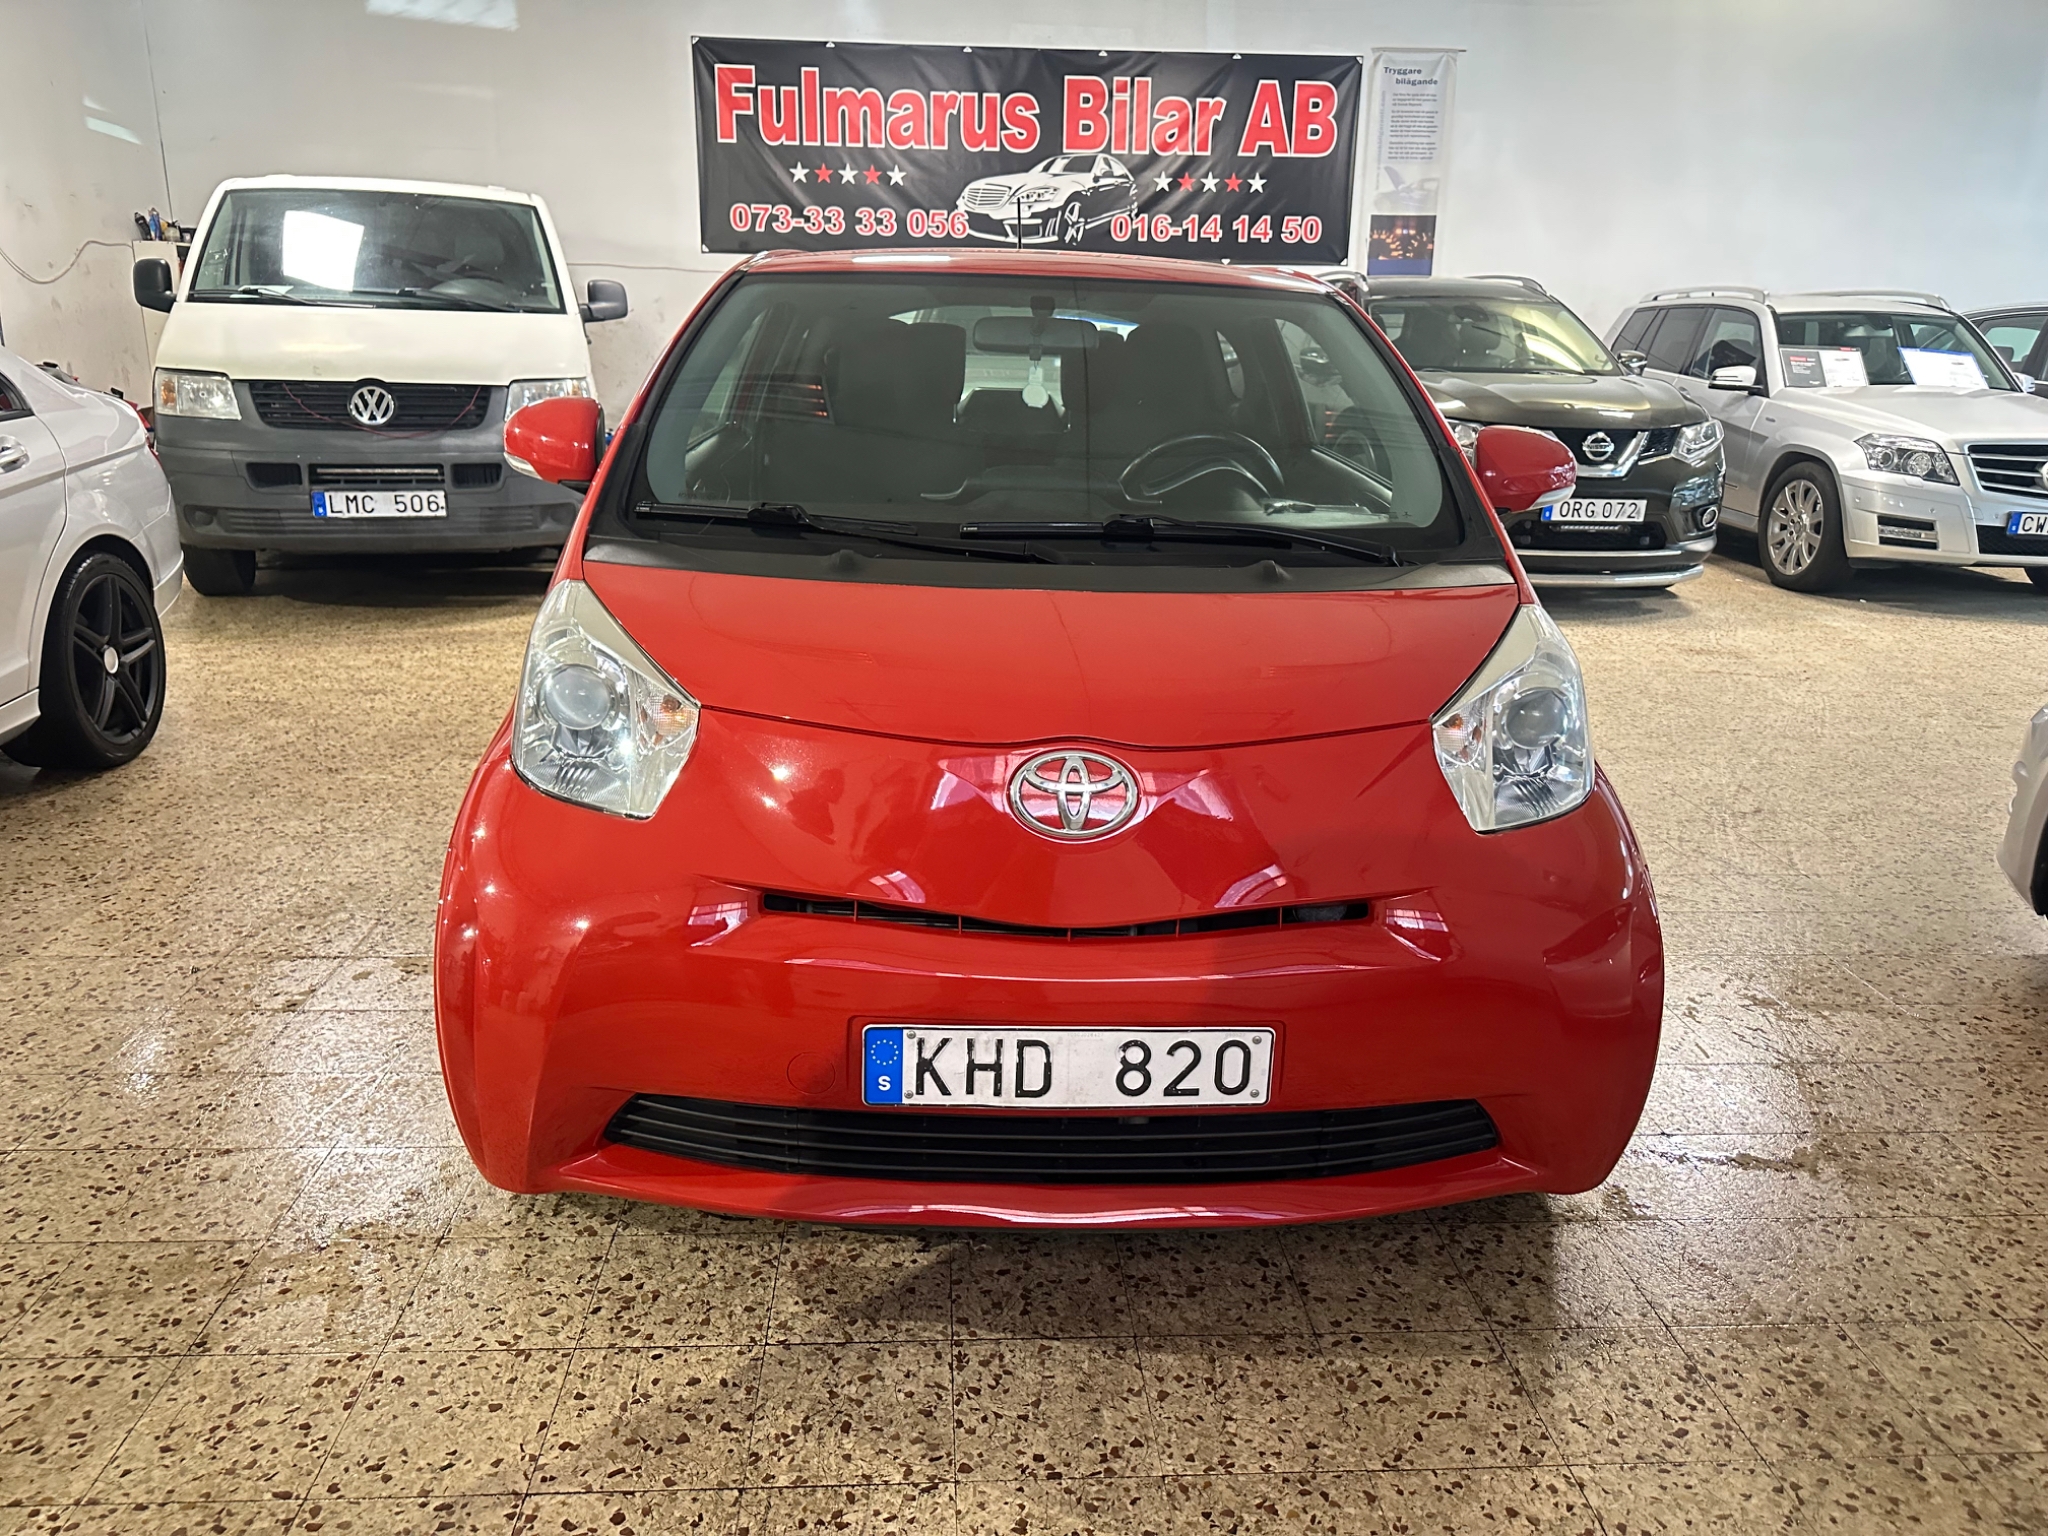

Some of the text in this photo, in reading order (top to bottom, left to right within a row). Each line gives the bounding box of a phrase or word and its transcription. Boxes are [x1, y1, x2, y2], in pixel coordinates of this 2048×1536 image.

[1383, 66, 1422, 75] Tryggare
[1395, 77, 1438, 86] bilägande
[714, 63, 1041, 153] Fulmarus
[1062, 75, 1227, 156] Bilar
[1237, 79, 1338, 158] AB
[729, 203, 970, 238] 073-33 33 056
[1110, 213, 1323, 244] 016-14 14 50
[328, 494, 375, 514] LMC
[393, 494, 440, 513] 506
[1560, 501, 1639, 519] ORG 072
[2022, 515, 2048, 533] CW
[915, 1037, 1252, 1099] KHD 820
[877, 1075, 891, 1091] S
